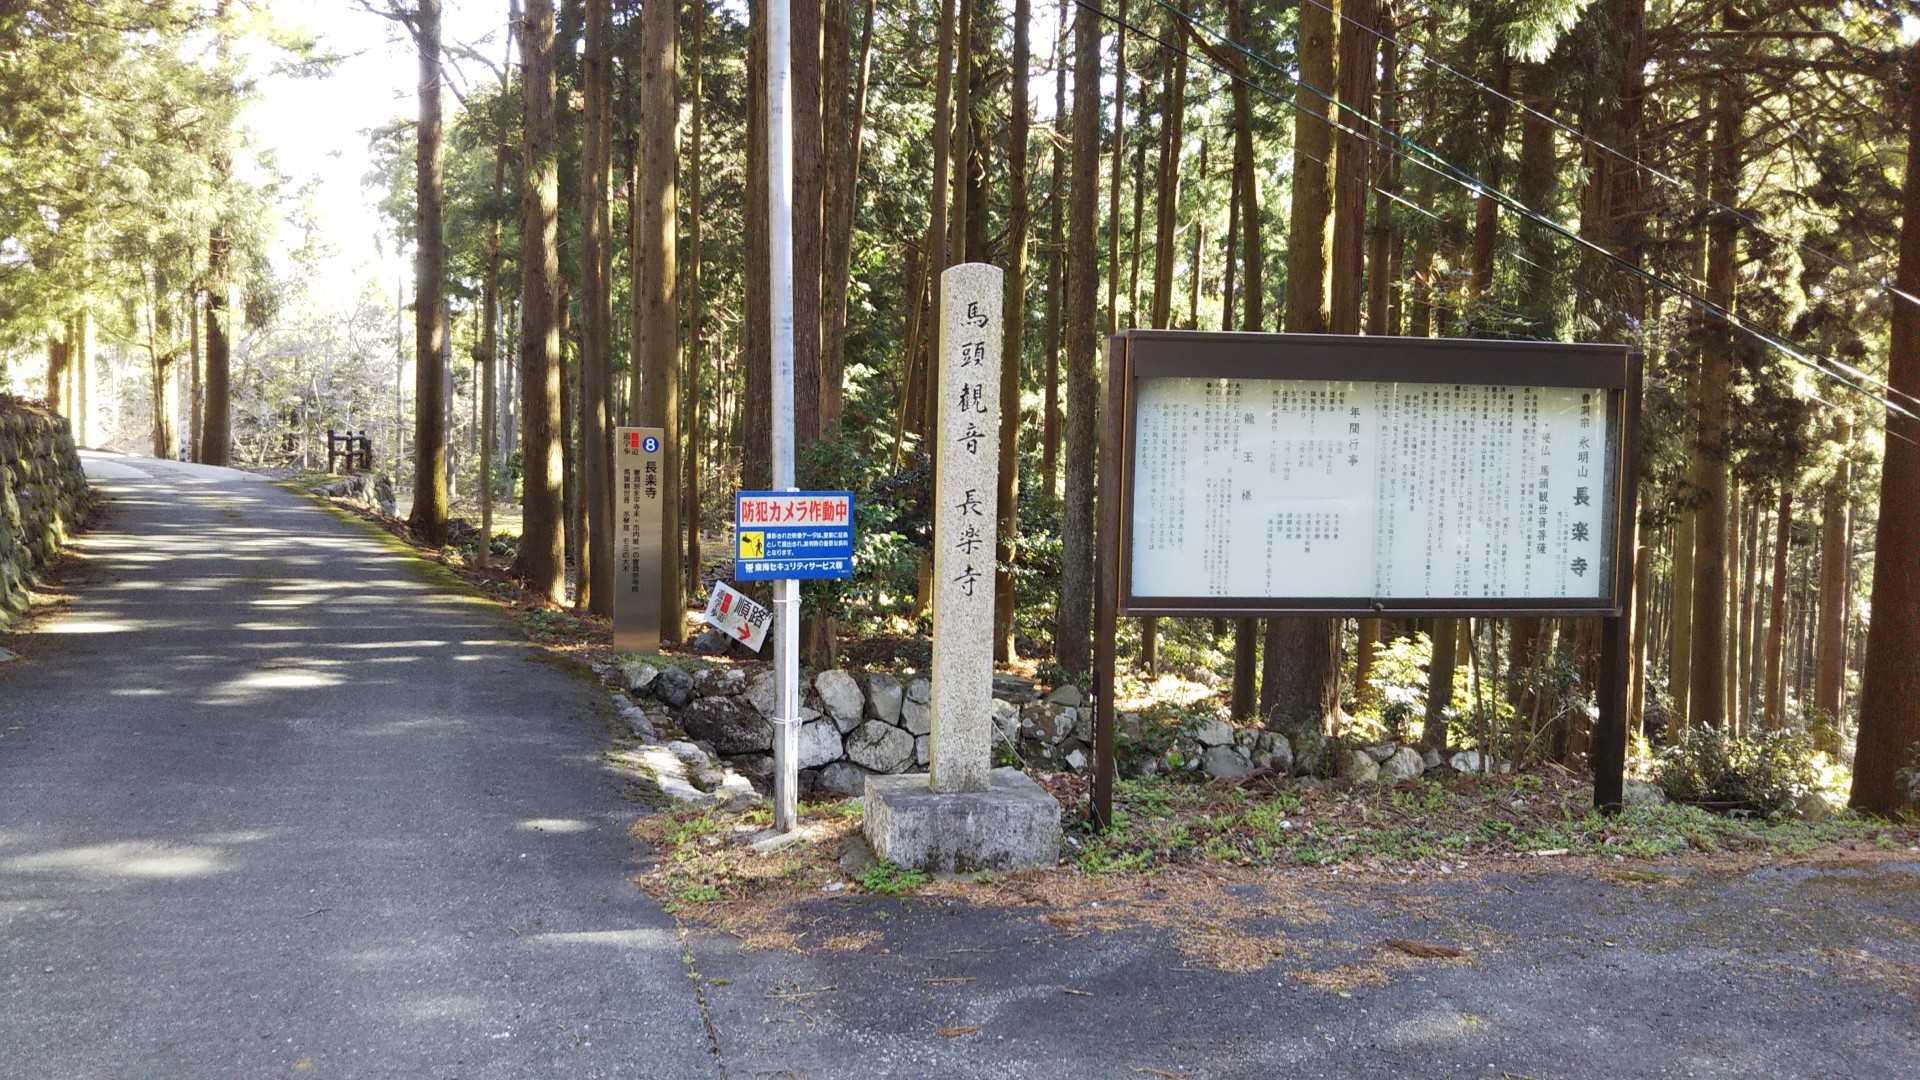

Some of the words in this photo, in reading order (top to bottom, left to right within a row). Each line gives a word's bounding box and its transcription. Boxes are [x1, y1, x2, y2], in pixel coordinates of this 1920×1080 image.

[645, 438, 656, 452] 8
[1347, 405, 1361, 467] 年間行事
[1576, 435, 1591, 479] 永明山
[645, 460, 657, 499] 長楽寺
[741, 500, 848, 523] 防犯カメラ作動中
[1569, 485, 1591, 578] 長楽寺
[952, 488, 984, 598] 長楽寺
[734, 597, 773, 629] 順路
